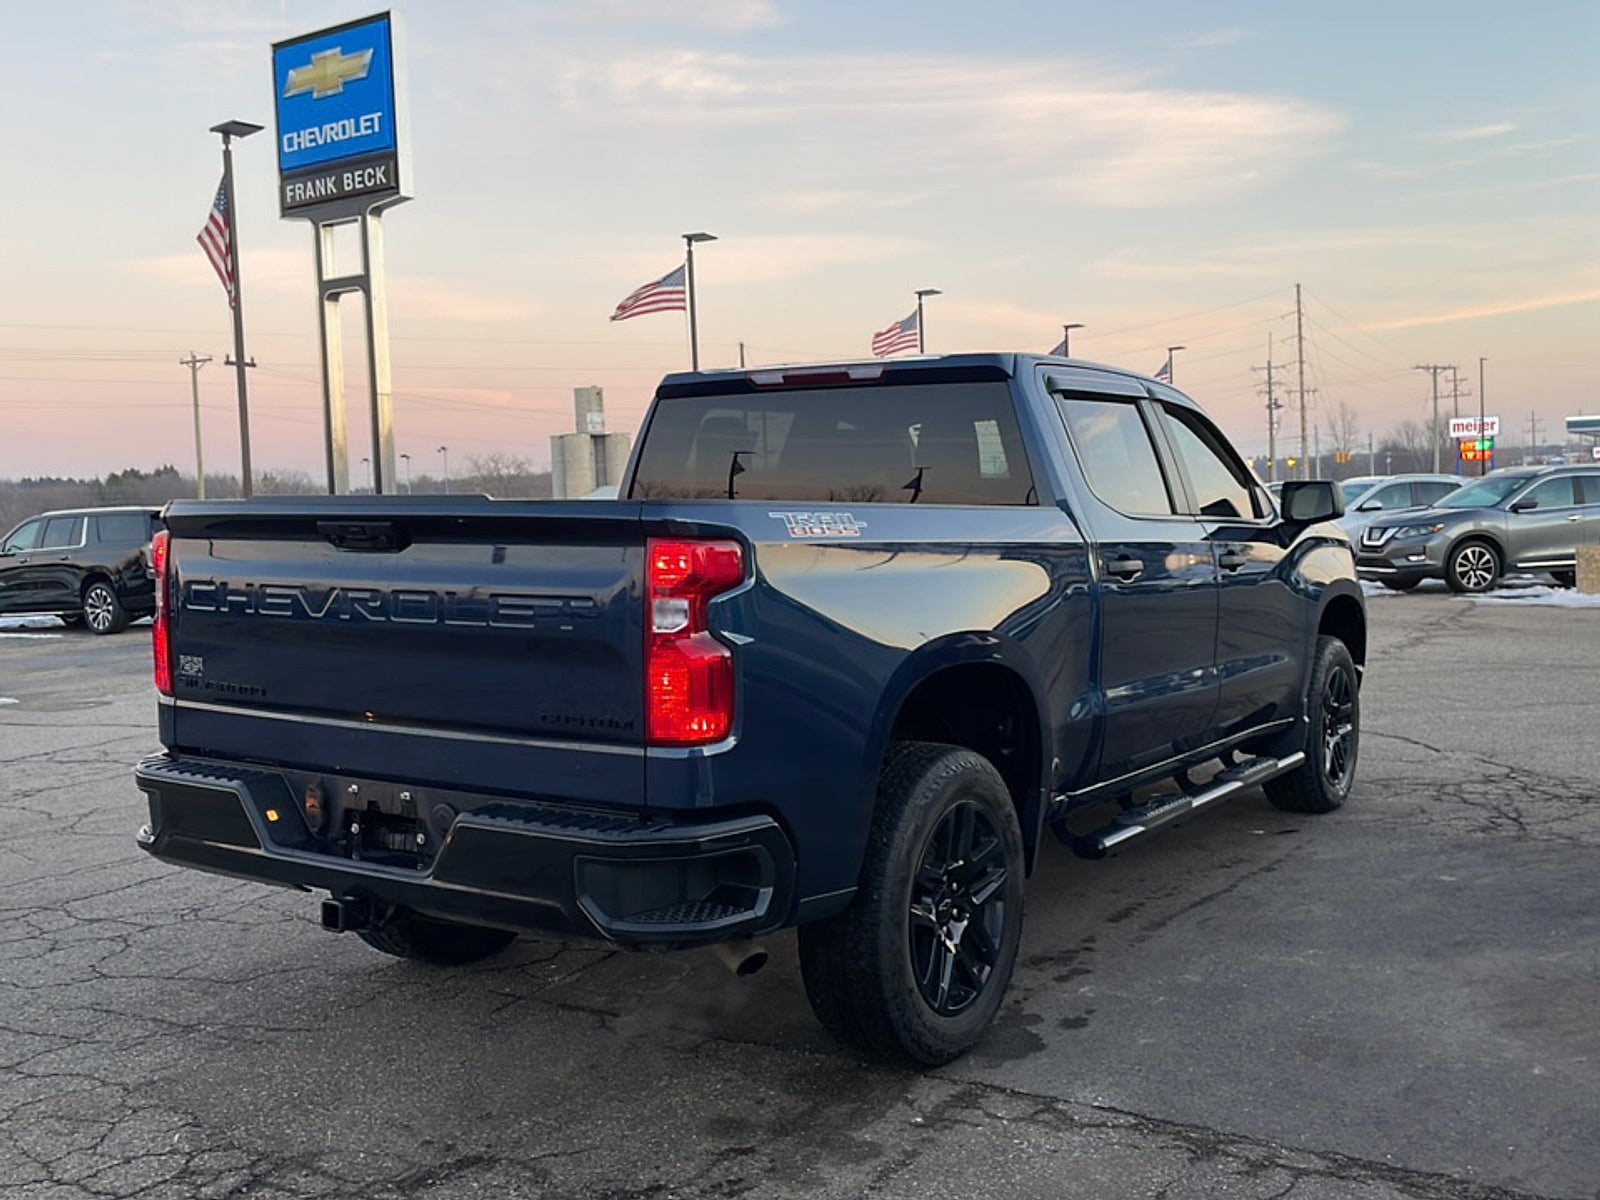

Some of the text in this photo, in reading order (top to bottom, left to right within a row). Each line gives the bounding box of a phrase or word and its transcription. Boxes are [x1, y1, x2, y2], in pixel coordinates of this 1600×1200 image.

[283, 112, 382, 153] CHEVROLET
[286, 165, 387, 203] FRANK BECK
[1452, 418, 1496, 434] meijer
[184, 580, 595, 630] CHEVROLET
